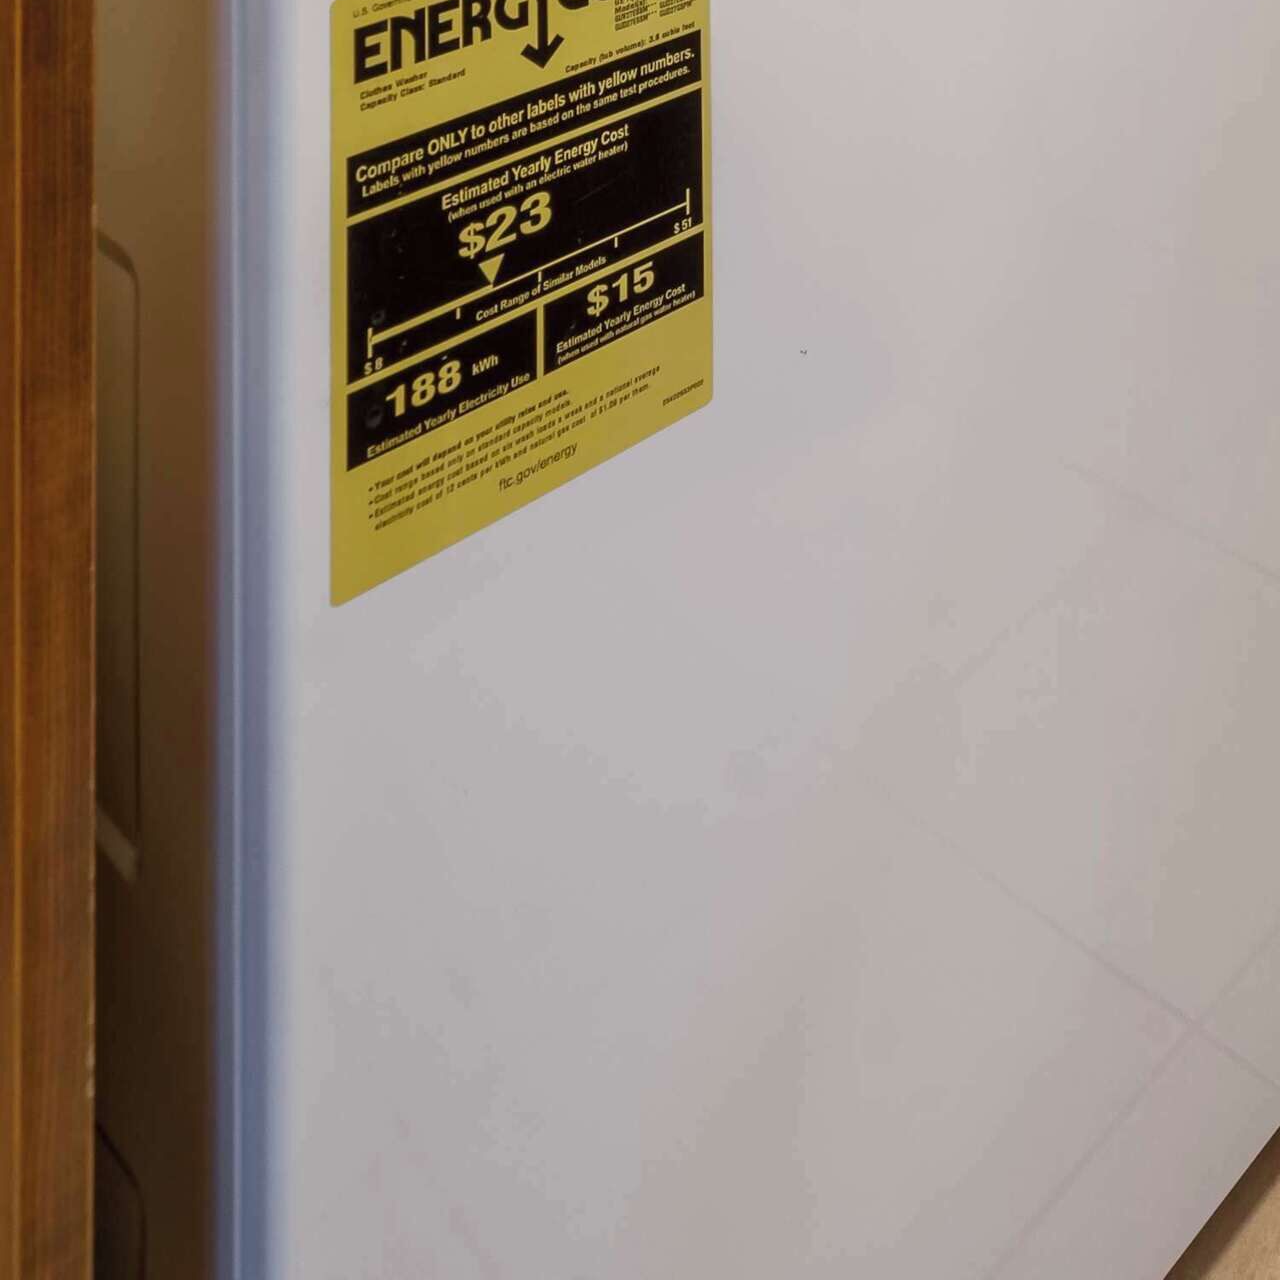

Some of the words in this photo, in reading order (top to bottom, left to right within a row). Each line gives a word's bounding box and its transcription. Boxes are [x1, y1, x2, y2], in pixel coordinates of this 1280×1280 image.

[356, 148, 424, 182] Compare
[428, 128, 467, 155] ONLY
[471, 124, 485, 139] to
[488, 109, 524, 133] other
[527, 94, 565, 119] labels
[569, 83, 595, 103] with
[598, 69, 637, 95] yellow
[641, 48, 695, 75] numbers.
[360, 84, 392, 99] Clothes
[396, 72, 427, 87] Washer
[360, 94, 397, 111] Capacity
[429, 68, 465, 87] Standard
[362, 175, 399, 198] Labels
[402, 167, 425, 181] with
[428, 153, 462, 175] yellow
[465, 134, 509, 158] numbers
[512, 128, 527, 140] are
[530, 116, 559, 132] based
[562, 109, 574, 121] on
[577, 104, 591, 116] the
[594, 92, 618, 108] same
[620, 87, 637, 99] test
[639, 66, 690, 94] procedures.
[442, 172, 509, 210] Estimated
[512, 155, 551, 180] Yearly
[555, 137, 598, 165] Energy
[601, 124, 629, 145] Cost
[448, 205, 477, 220] (when
[479, 191, 502, 207] used
[504, 184, 523, 198] with
[526, 176, 536, 189] an
[539, 164, 571, 186] electric
[573, 154, 596, 170] water
[599, 141, 628, 160] heater)
[458, 192, 552, 258] $23
[476, 303, 498, 321] Cost
[501, 291, 530, 309] Range
[531, 283, 541, 296] of
[543, 271, 574, 290] Similar
[576, 256, 607, 276] Models
[556, 325, 602, 354] Estimated
[604, 310, 632, 333] Yearly
[633, 295, 664, 315] Energy
[666, 283, 685, 298] Cost
[587, 261, 654, 316] $15
[557, 348, 580, 365] (when
[581, 339, 598, 353] used
[600, 331, 614, 343] with
[616, 317, 639, 336] natural
[640, 312, 652, 325] gas
[654, 303, 672, 317] water
[672, 290, 696, 305] heater)
[366, 424, 422, 459] Estimated
[424, 406, 457, 432] Yearly
[458, 383, 510, 412] Electricity
[511, 372, 530, 388] Use
[386, 360, 462, 417] 188
[472, 355, 499, 376] kWh
[499, 443, 577, 491] ftc.gov/energy
